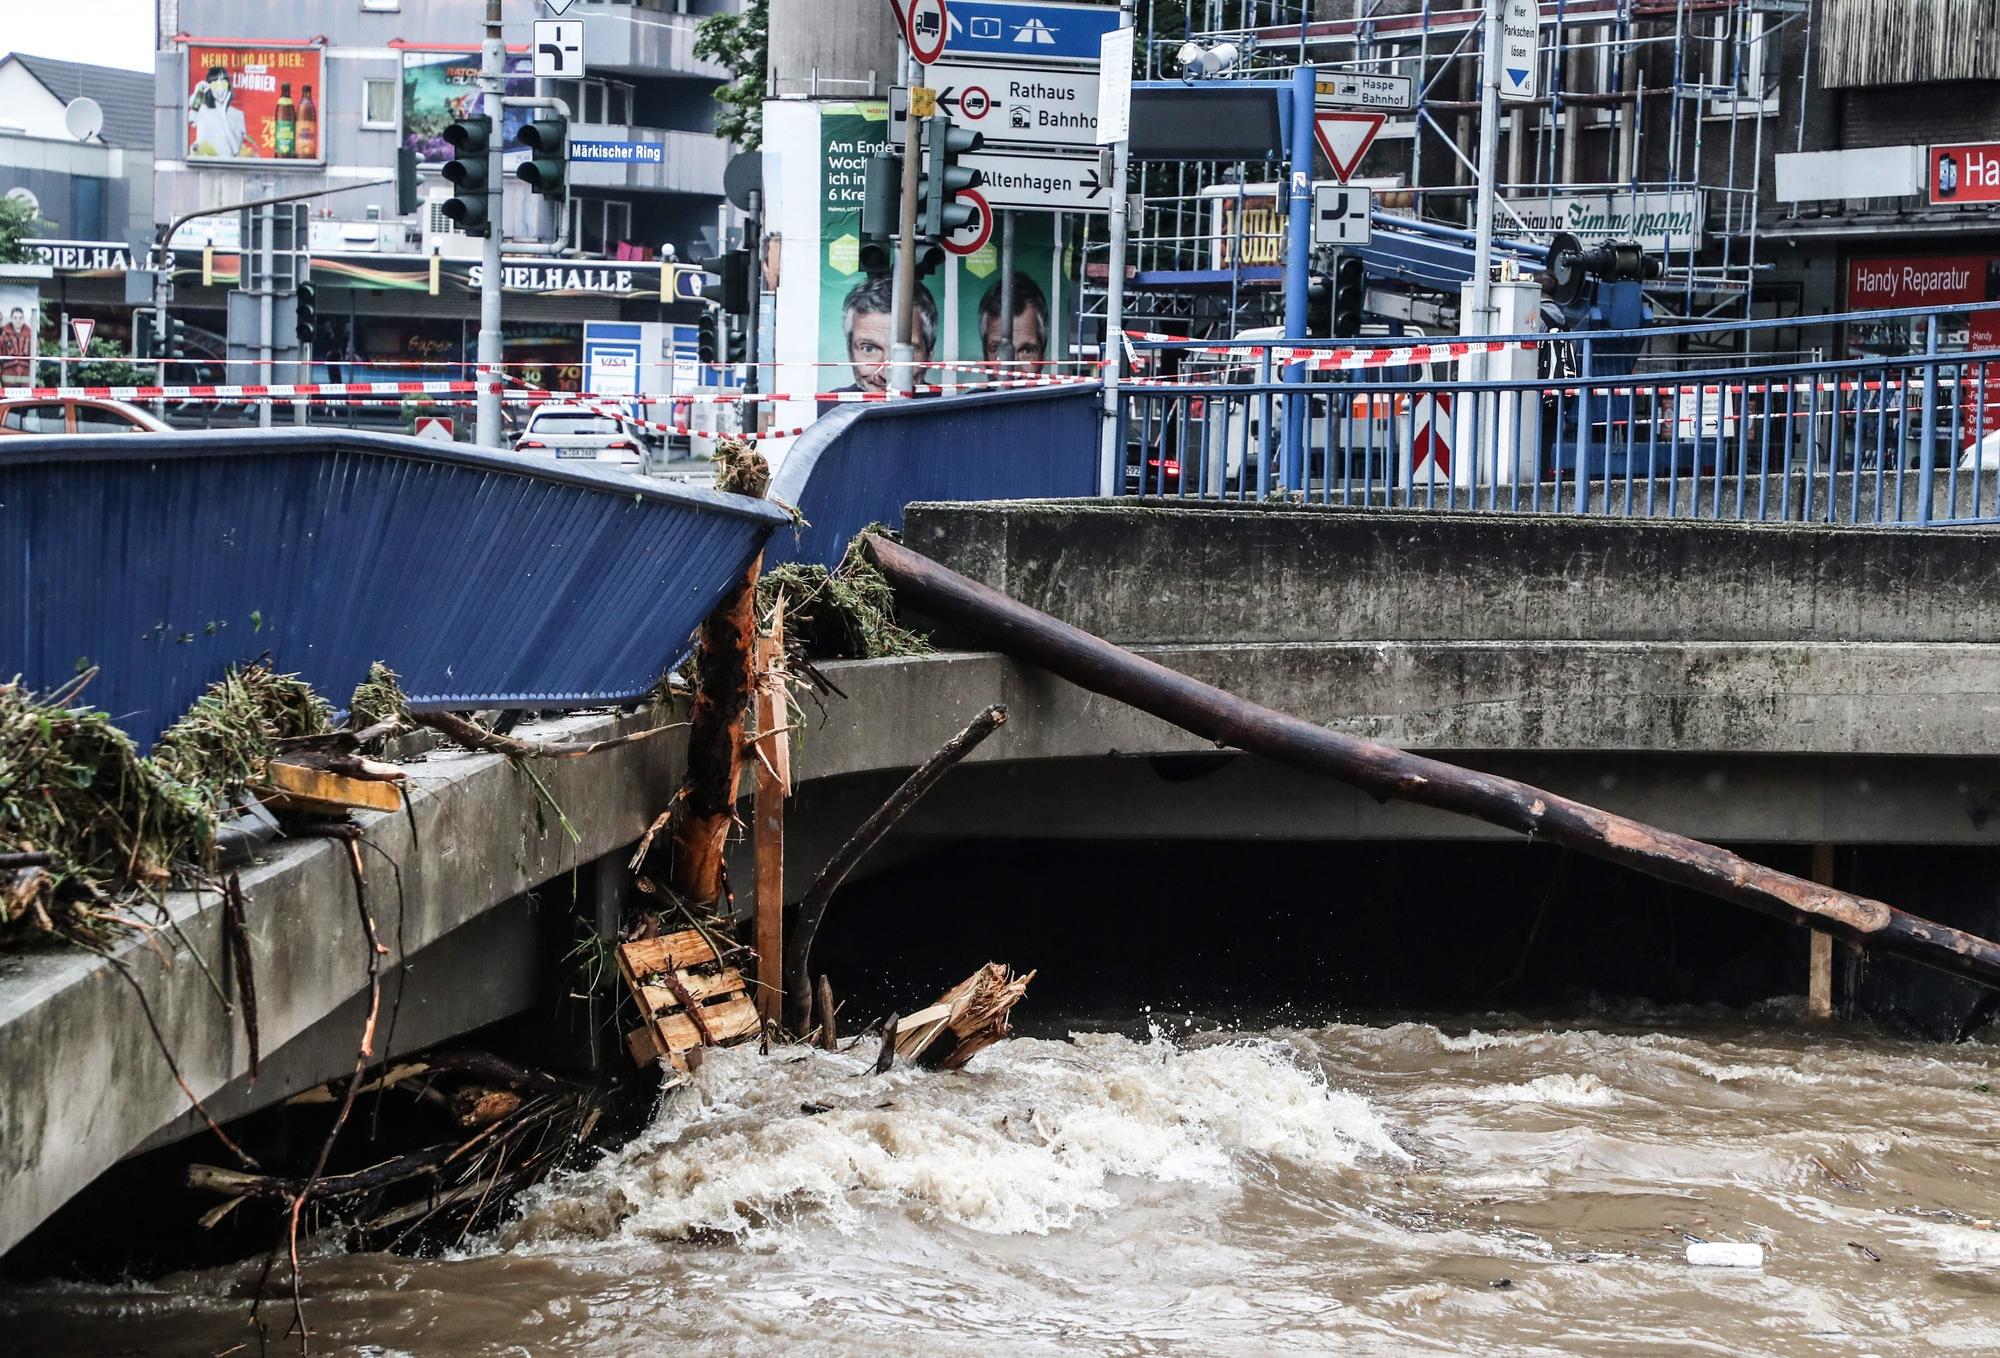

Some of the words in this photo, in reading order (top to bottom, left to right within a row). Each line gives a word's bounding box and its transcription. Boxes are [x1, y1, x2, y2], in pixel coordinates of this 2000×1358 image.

[1514, 5, 1527, 18] Hier
[983, 22, 989, 34] 1
[1504, 24, 1535, 39] Parkschein
[1510, 45, 1527, 57] lösen
[201, 53, 229, 68] MEHR
[1009, 81, 1076, 101] Rathaus
[1322, 83, 1328, 93] 7
[1362, 79, 1394, 92] Haspe
[1362, 93, 1404, 105] Bahnhof
[572, 143, 633, 158] Märkischer
[635, 145, 661, 162] Ring
[828, 140, 853, 153] Am
[857, 140, 893, 153] Ende
[1965, 151, 2000, 187] Ha
[828, 172, 849, 185] ich
[981, 171, 1072, 193] Altenhagen
[828, 189, 838, 201] 6
[1567, 202, 1693, 239] Zimmemann
[468, 266, 633, 292] SIELHALLE
[1856, 267, 1899, 297] Handy
[1902, 266, 1970, 296] Reparatur
